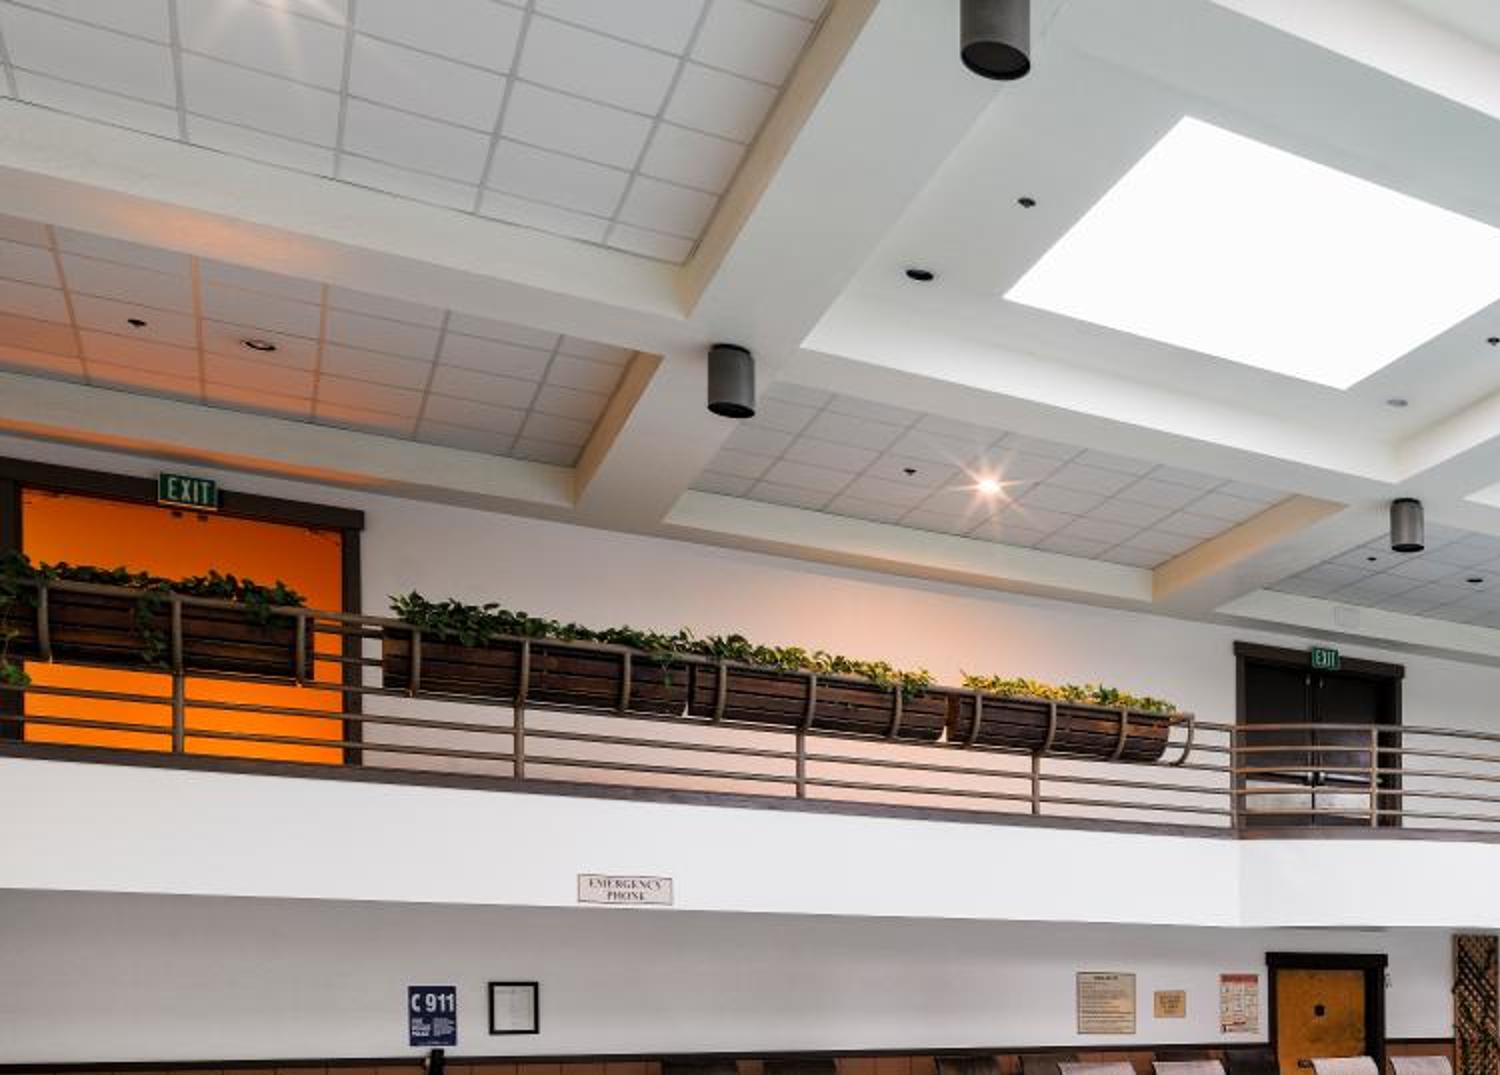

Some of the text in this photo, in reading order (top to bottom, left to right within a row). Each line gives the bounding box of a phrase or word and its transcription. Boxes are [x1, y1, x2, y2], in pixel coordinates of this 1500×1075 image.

[167, 477, 210, 504] EXIT
[589, 878, 662, 890] EMERGENCY
[607, 891, 644, 900] PHONE
[425, 993, 454, 1012] 911
